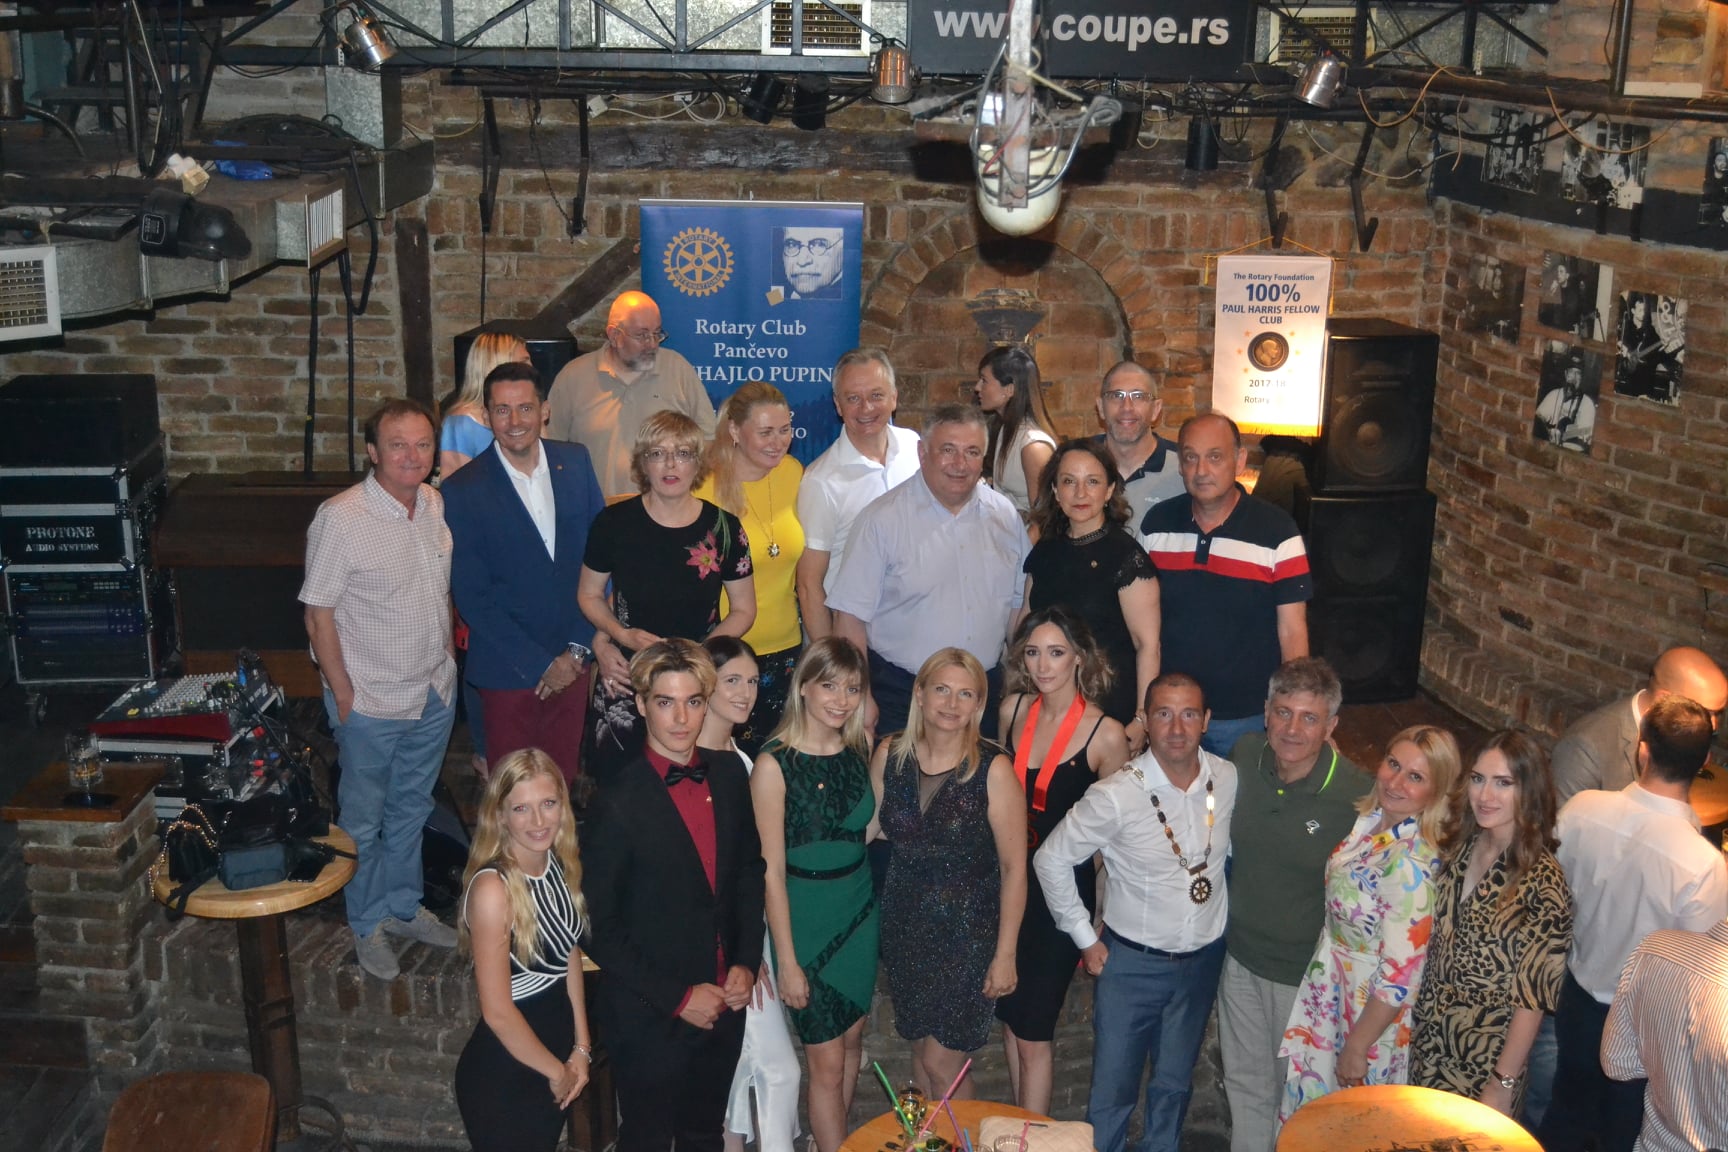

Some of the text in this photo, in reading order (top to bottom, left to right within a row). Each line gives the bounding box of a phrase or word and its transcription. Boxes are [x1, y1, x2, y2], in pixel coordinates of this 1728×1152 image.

[1233, 272, 1246, 280] The
[1248, 273, 1272, 282] Rotary
[1245, 283, 1301, 303] 100%
[1222, 304, 1320, 314] PAUL HARRIS FELLOW
[1259, 315, 1283, 324] CLUB
[695, 319, 807, 339] Rotary Club
[713, 342, 788, 359] Pančevo
[693, 365, 764, 385] HAJLO
[26, 526, 95, 539] PROTONE
